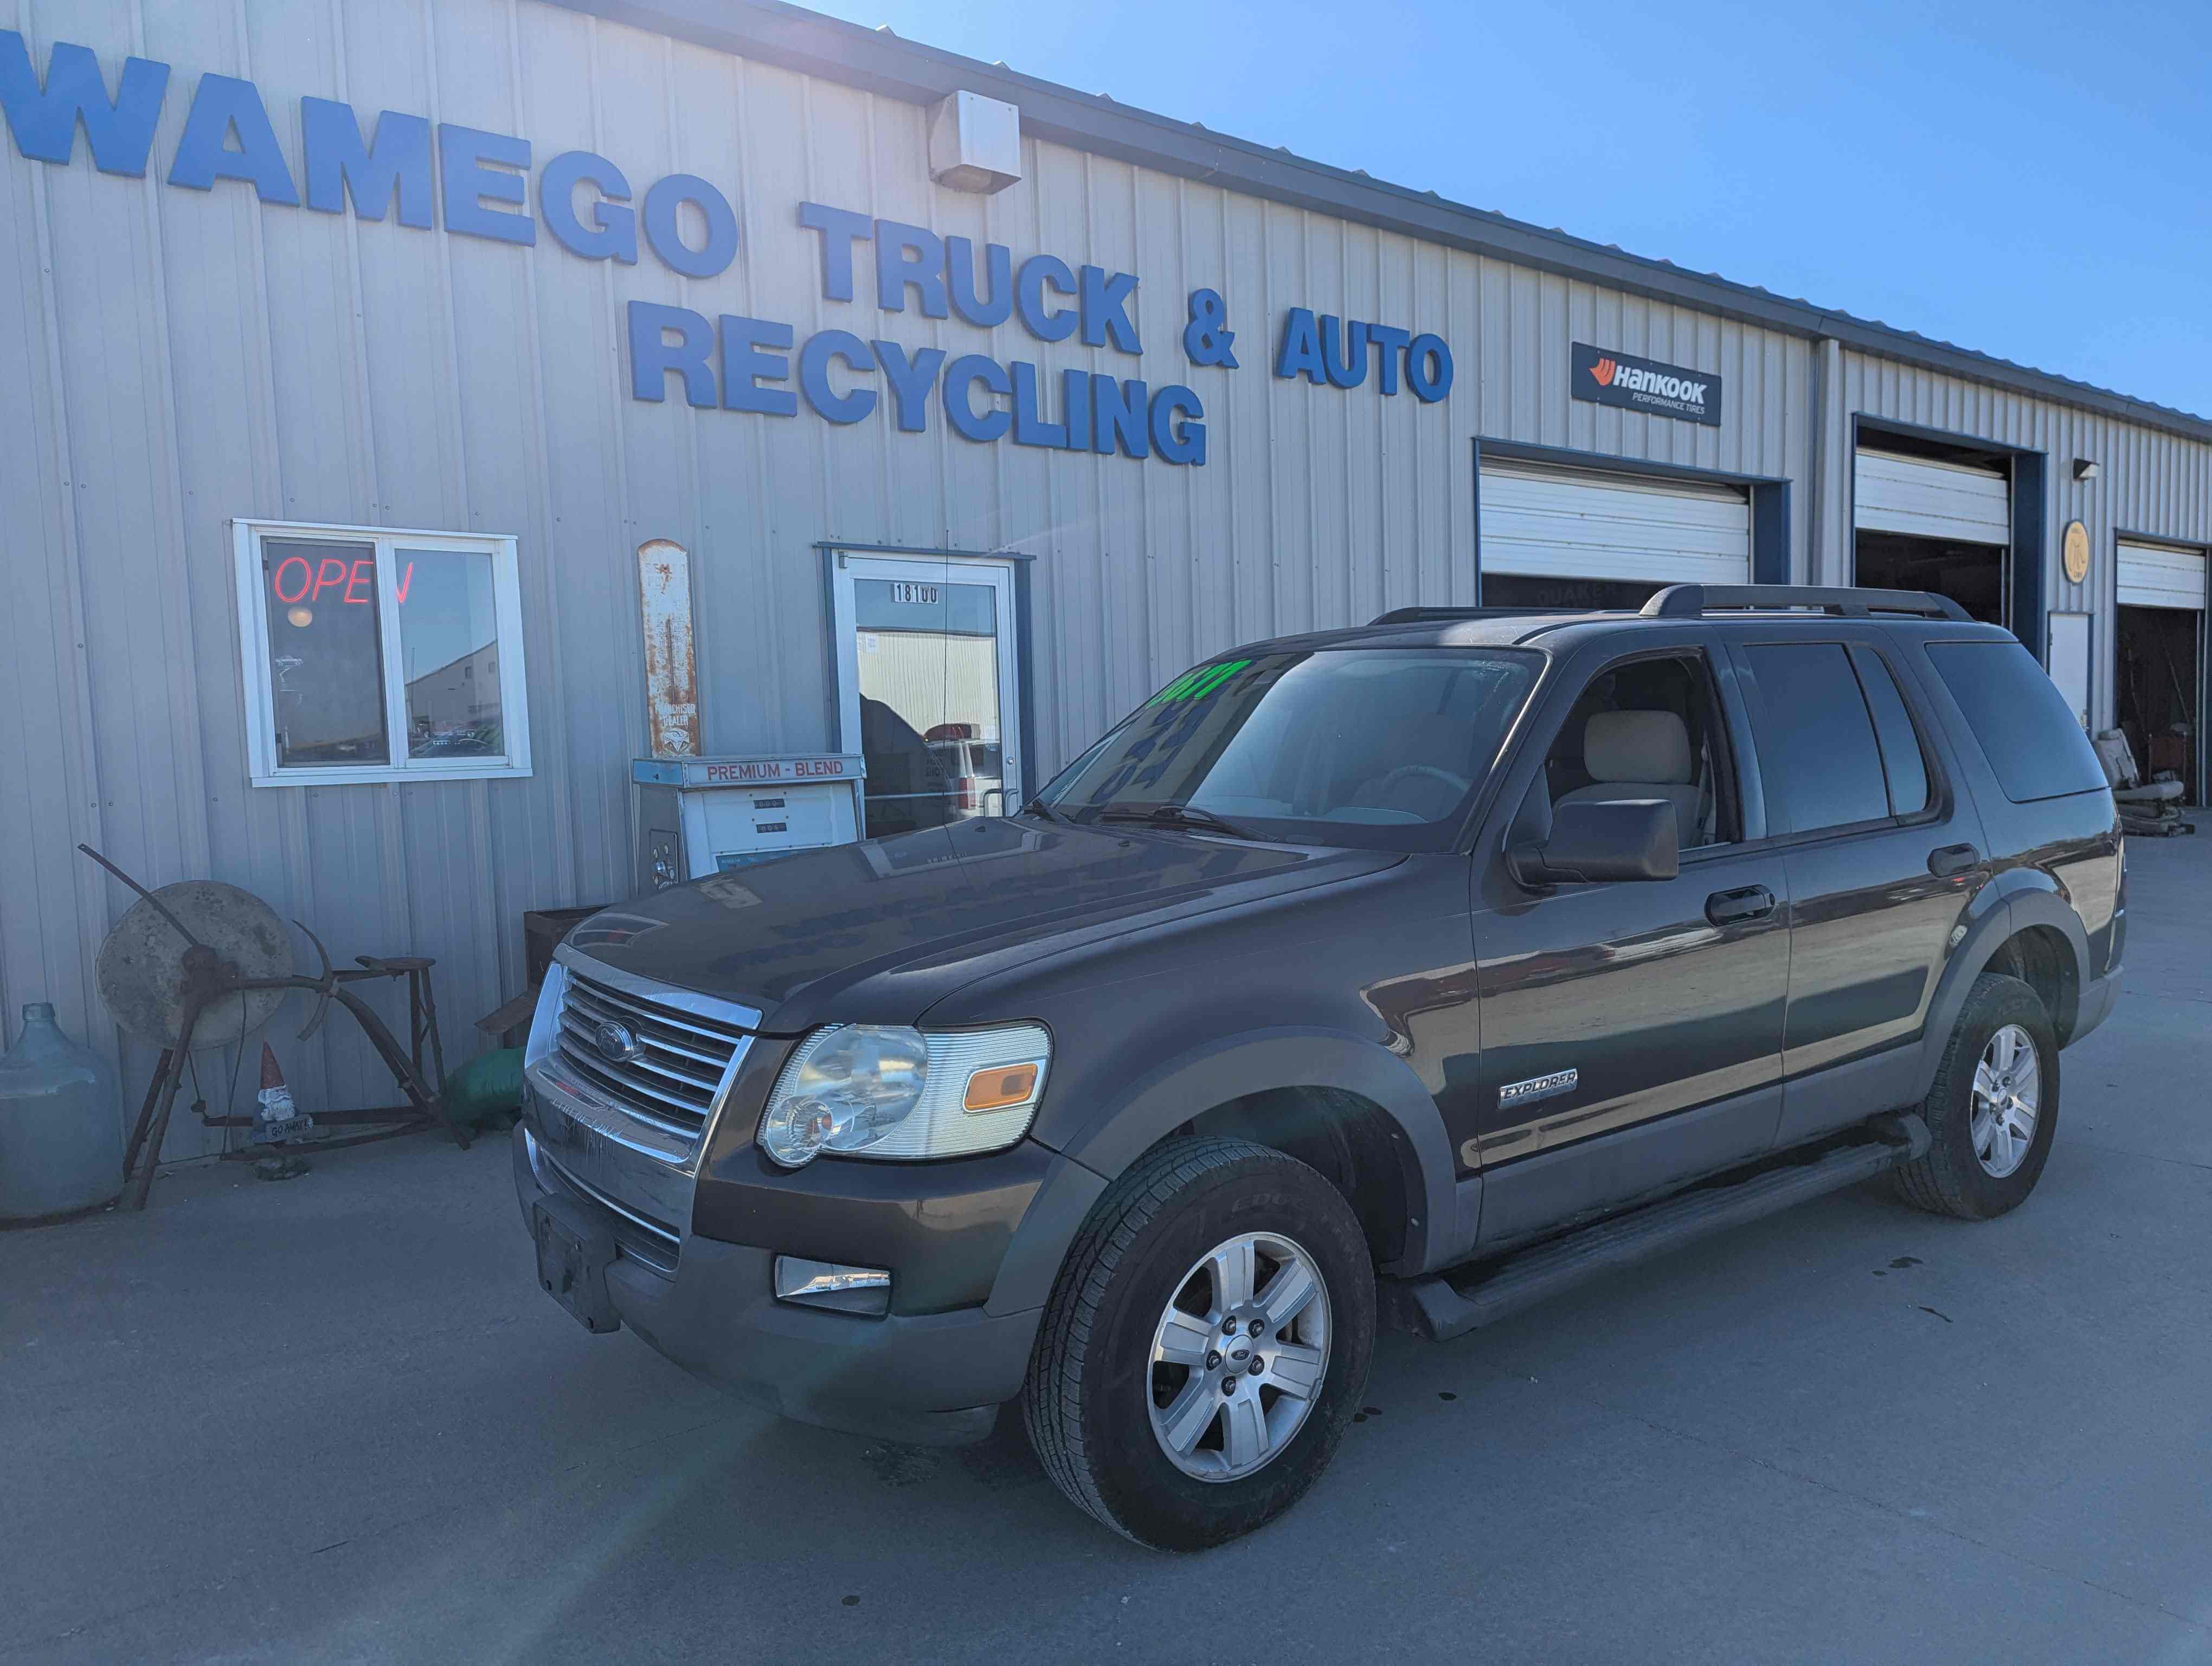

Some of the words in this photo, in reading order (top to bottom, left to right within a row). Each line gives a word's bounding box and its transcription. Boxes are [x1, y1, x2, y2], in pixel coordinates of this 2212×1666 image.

[0, 28, 739, 279] WAMEGO
[798, 201, 1144, 356] TRUCK
[1183, 287, 1240, 369] &
[1275, 306, 1454, 403] AUTO
[627, 299, 1207, 467] RECYCLING
[1632, 392, 1685, 411] PERFORMANCE
[1686, 402, 1706, 415] TIRES
[896, 583, 937, 603] 18100
[707, 763, 781, 781] PREMIUM
[794, 760, 844, 777] BLEND
[1503, 1071, 1576, 1099] EXPLORER
[272, 1124, 283, 1137] GO
[285, 1118, 307, 1134] AWAY!
